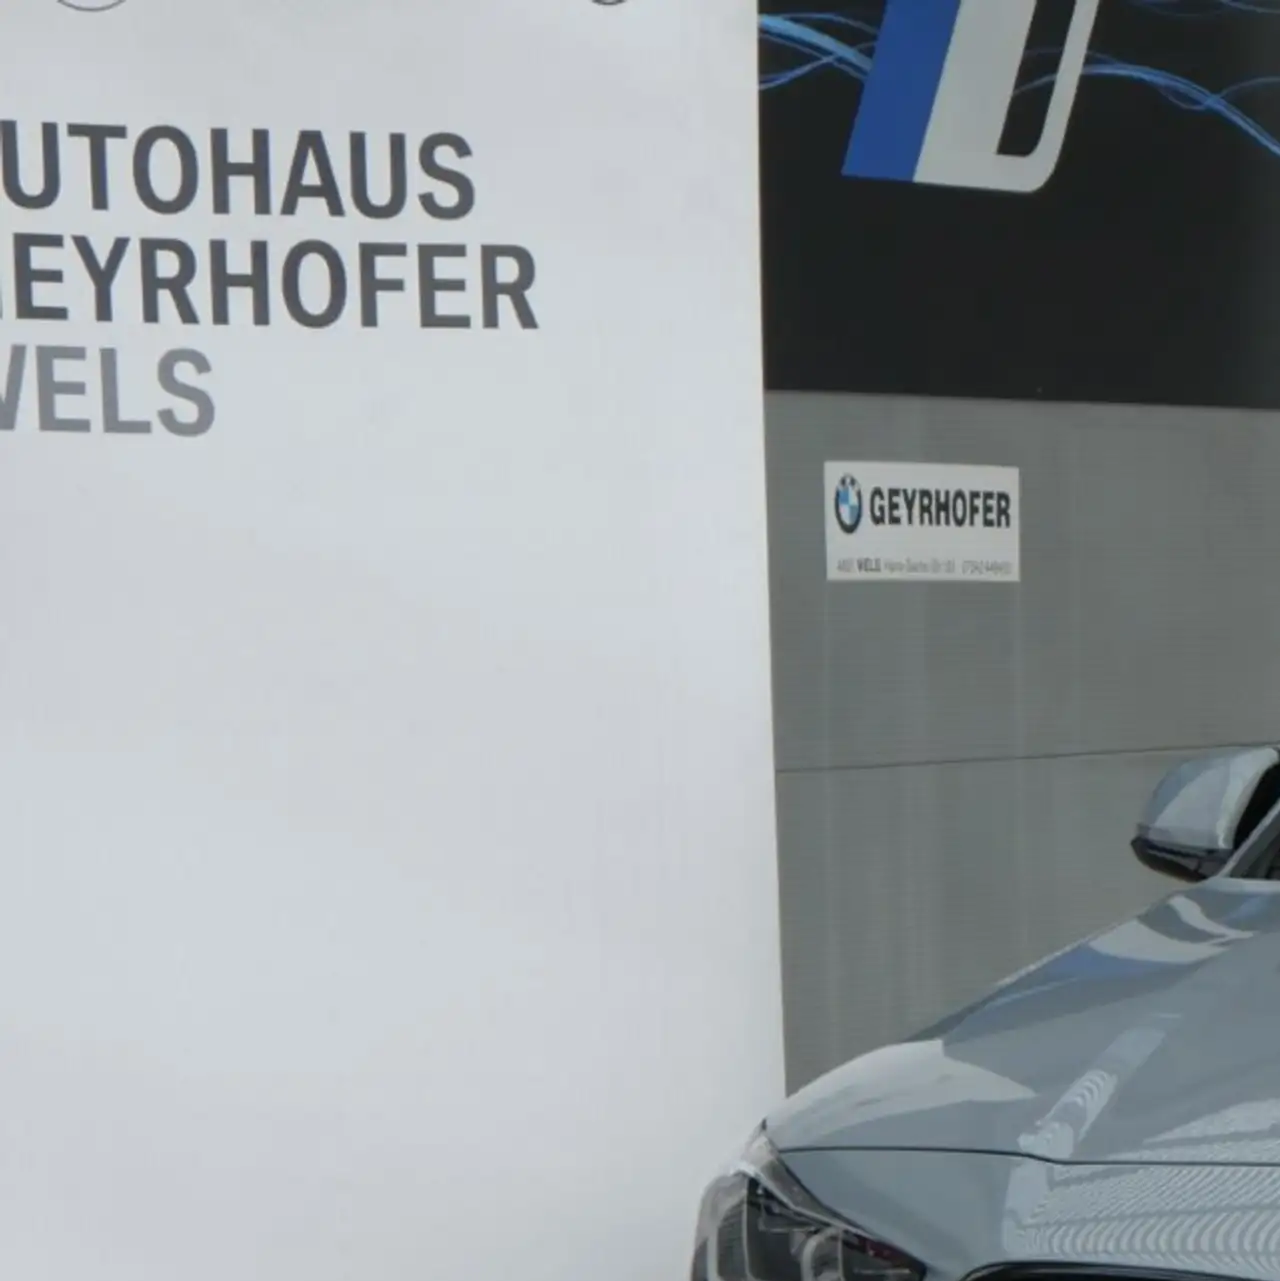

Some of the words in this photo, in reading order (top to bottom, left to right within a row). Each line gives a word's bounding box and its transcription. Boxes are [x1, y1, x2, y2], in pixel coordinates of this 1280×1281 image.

[0, 120, 476, 221] UTOHAUS
[0, 232, 540, 330] EYRHOFER
[869, 486, 1011, 528] GEYRHOFER
